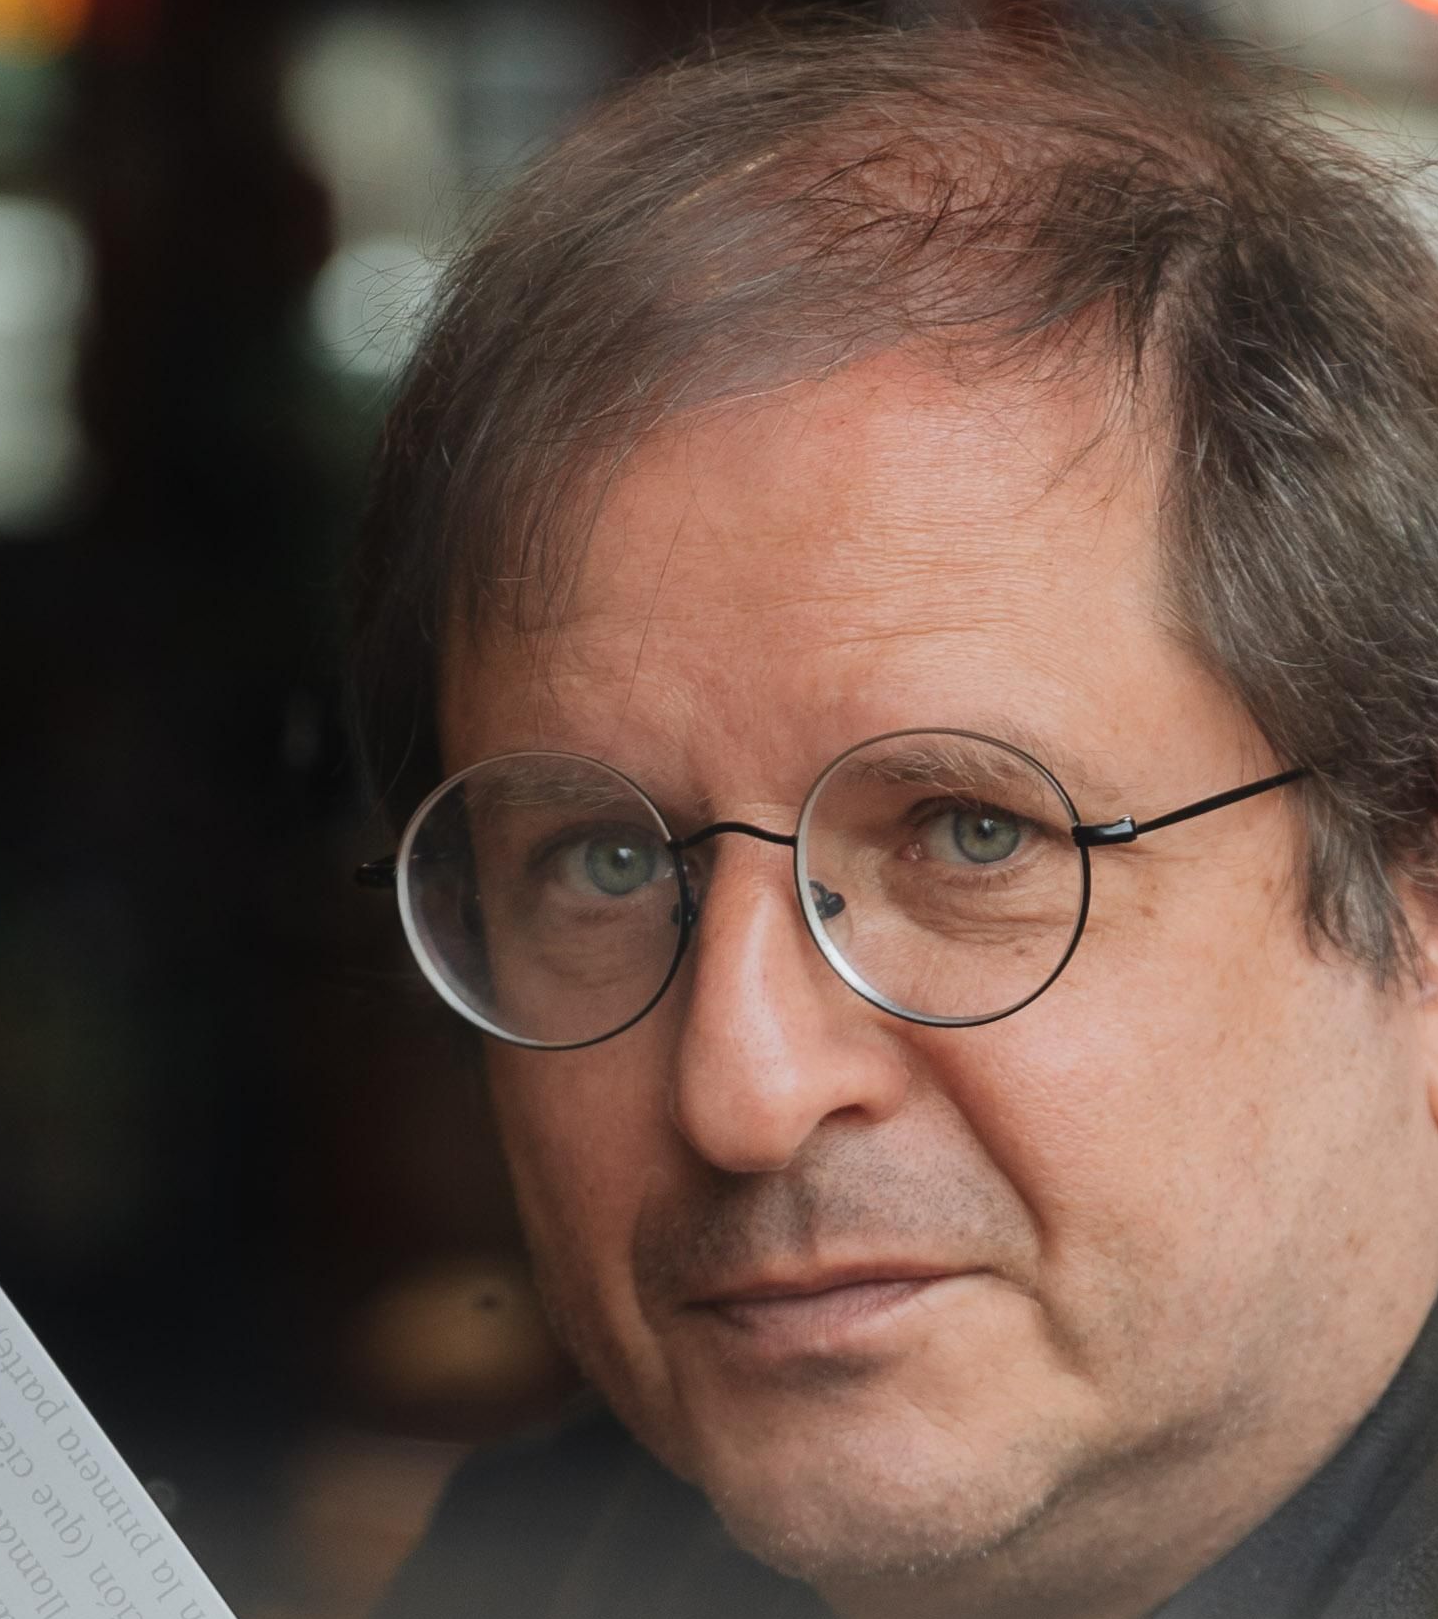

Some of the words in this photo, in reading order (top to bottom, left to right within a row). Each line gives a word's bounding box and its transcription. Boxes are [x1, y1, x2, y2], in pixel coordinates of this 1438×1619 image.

[31, 1483, 94, 1559] (que
[56, 1425, 165, 1559] primera
[150, 1558, 185, 1604] la
